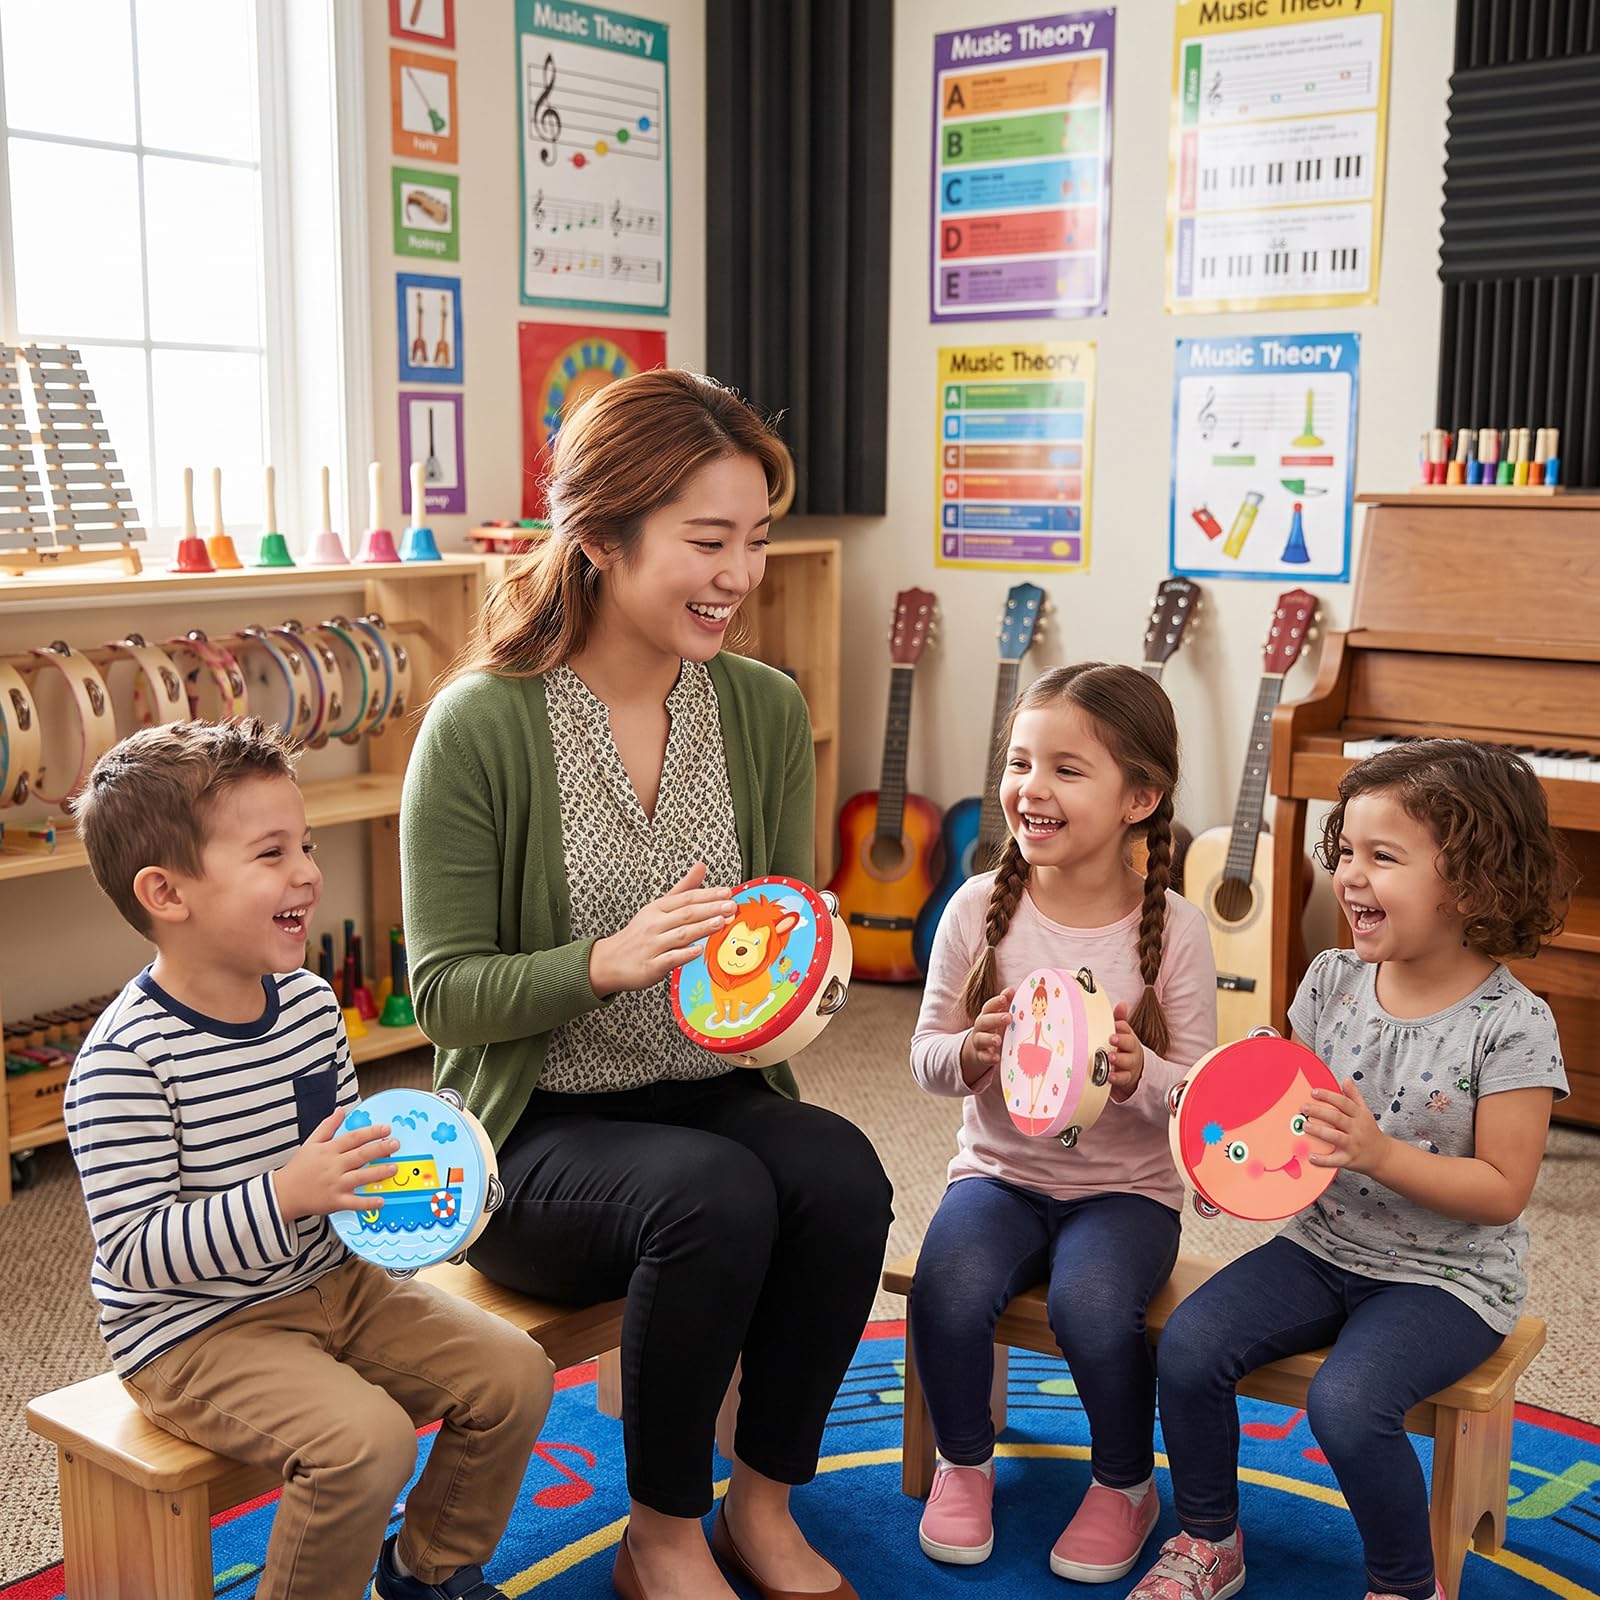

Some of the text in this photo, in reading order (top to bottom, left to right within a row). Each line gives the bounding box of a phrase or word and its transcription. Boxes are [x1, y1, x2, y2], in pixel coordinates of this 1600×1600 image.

[1198, 0, 1268, 26] Music
[534, 1, 654, 56] Music Theory
[951, 21, 1096, 61] Music Theory
[946, 84, 966, 111] A
[946, 131, 963, 158] B
[945, 178, 963, 206] C
[945, 226, 962, 253] D
[946, 272, 960, 299] E
[950, 351, 1080, 373] Music Theory
[1190, 341, 1343, 369] Music Theory
[947, 388, 959, 405] A
